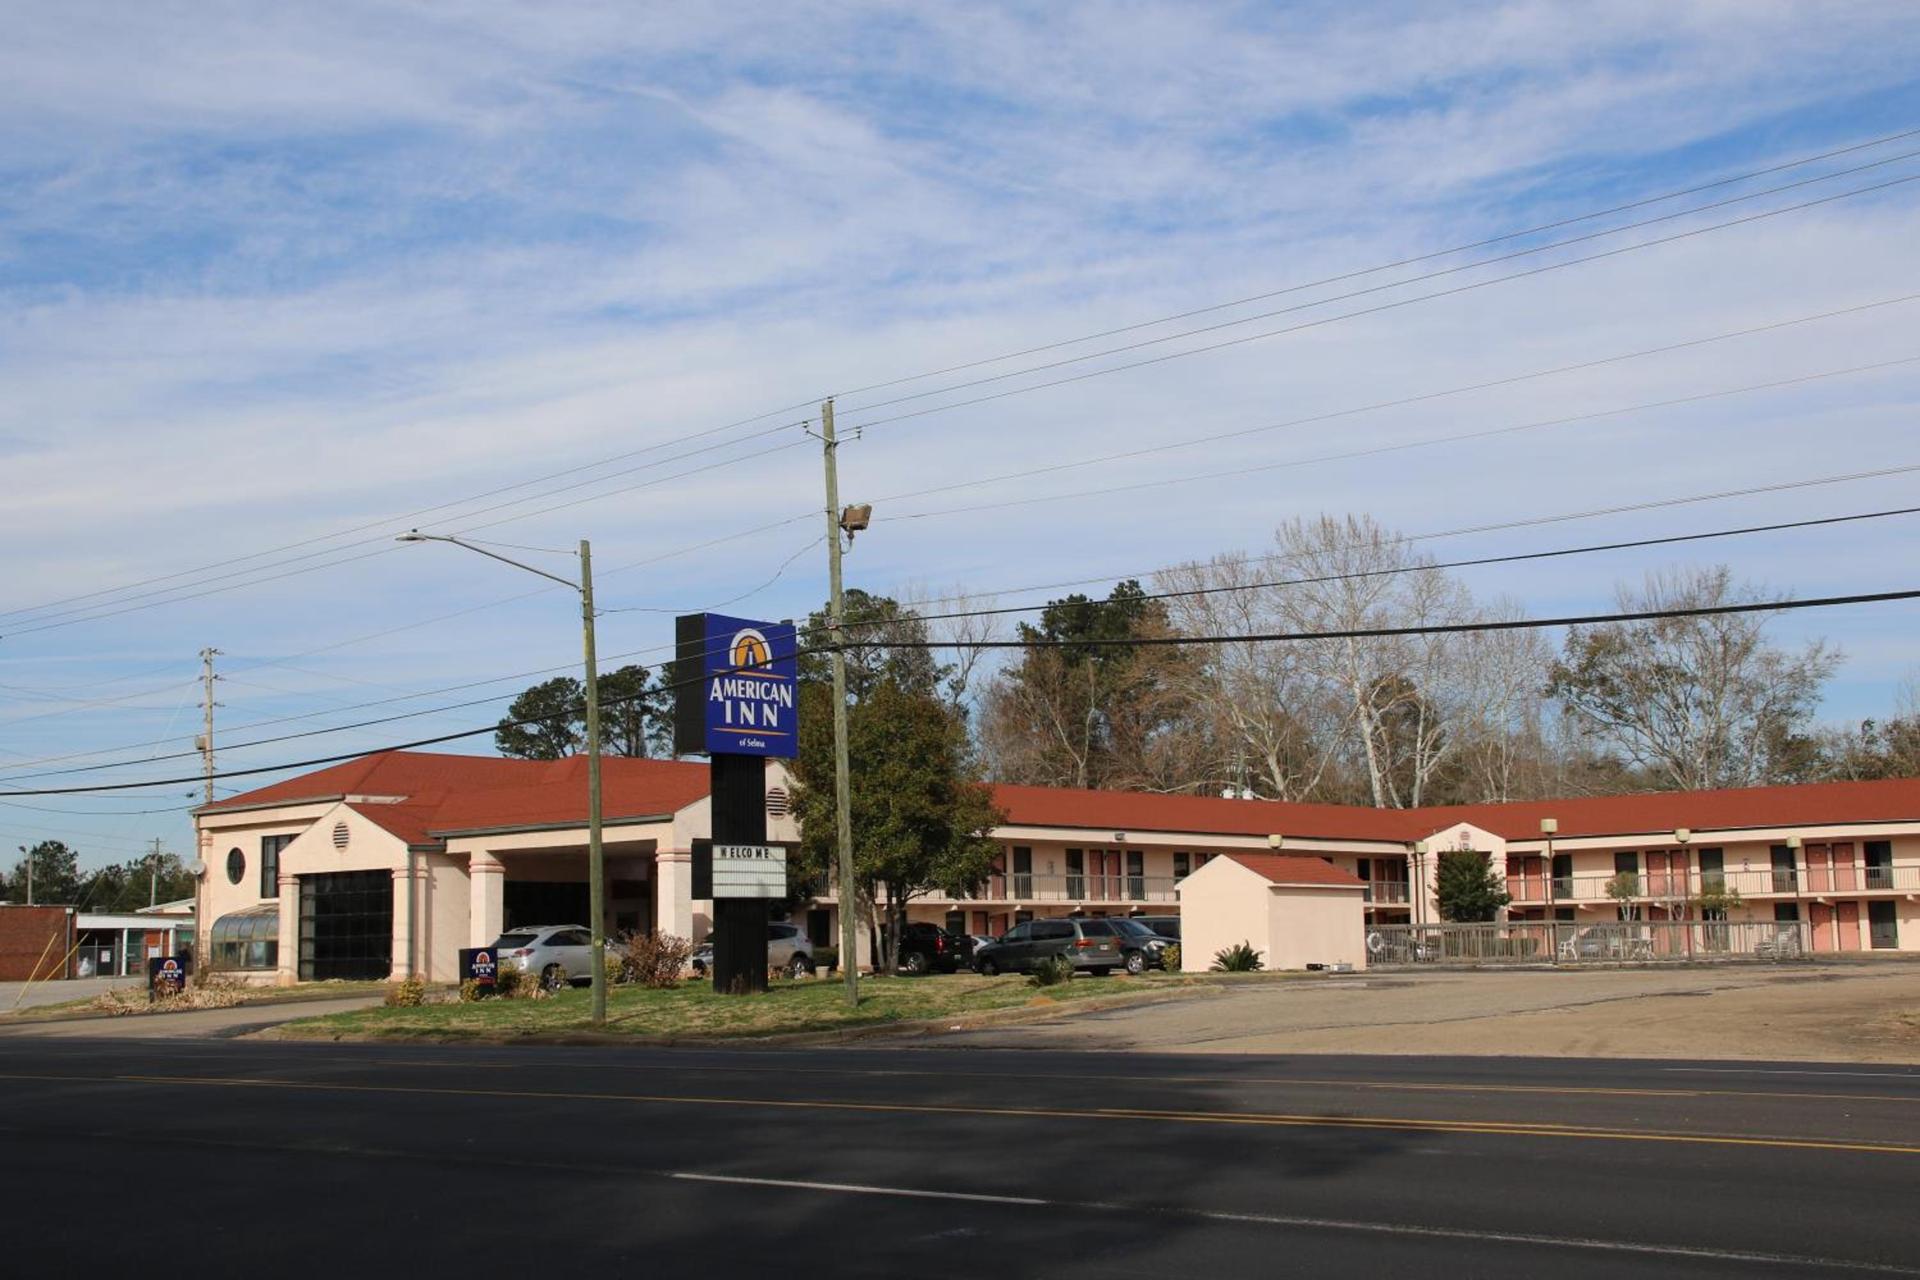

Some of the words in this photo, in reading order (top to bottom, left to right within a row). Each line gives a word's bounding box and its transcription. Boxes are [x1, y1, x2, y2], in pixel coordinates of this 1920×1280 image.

[710, 677, 792, 708] AMERICAN
[725, 700, 778, 727] INN
[739, 738, 746, 747] of
[721, 847, 769, 859] WELCOME
